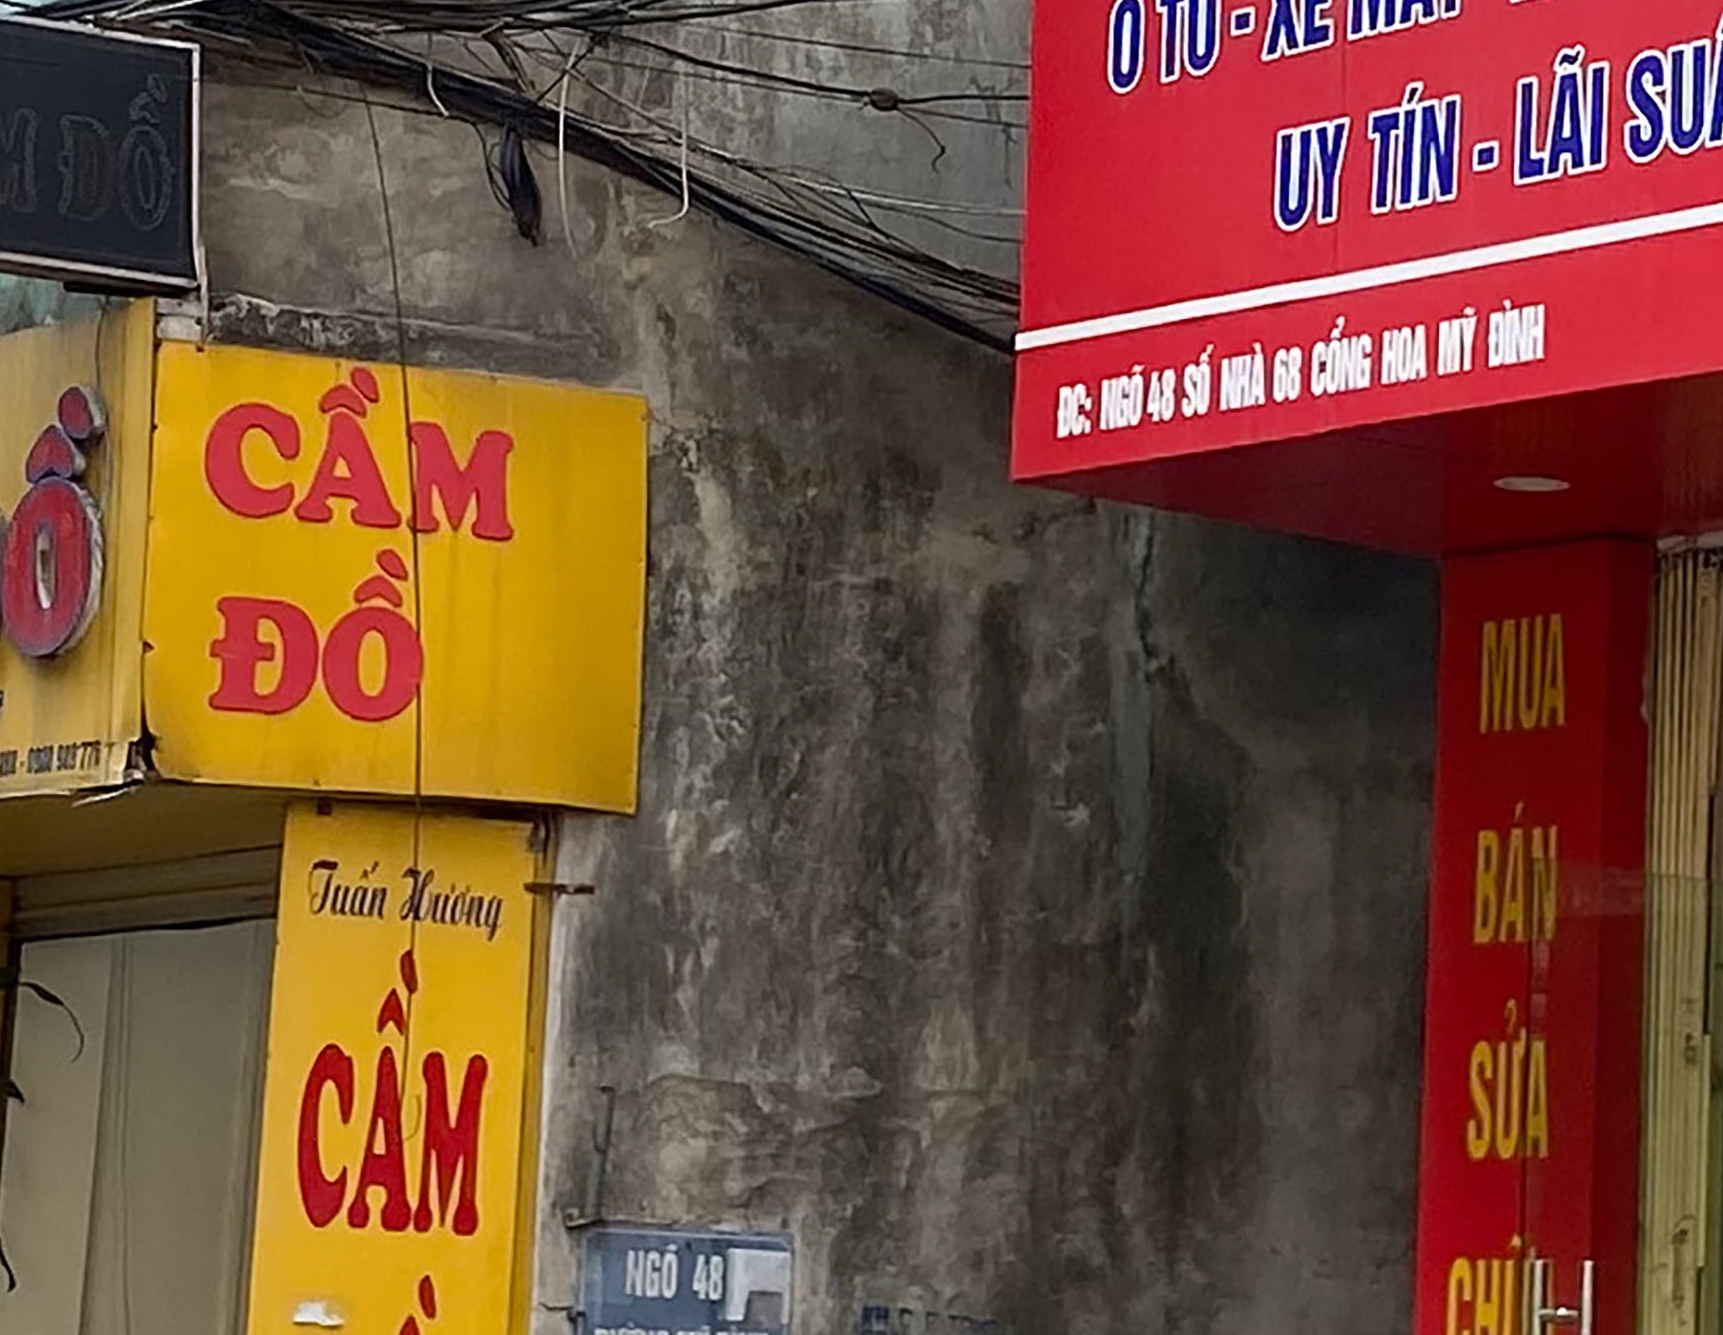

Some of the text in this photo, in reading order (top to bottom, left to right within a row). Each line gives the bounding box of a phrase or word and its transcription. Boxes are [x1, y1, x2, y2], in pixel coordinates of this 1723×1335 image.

[1274, 115, 1350, 232] UY
[1368, 80, 1462, 217] TÍN
[1512, 45, 1611, 186] LÃI
[1100, 367, 1143, 430] NGÕ
[1146, 374, 1175, 423] 48
[1182, 344, 1214, 415] SỐ
[1219, 343, 1265, 411] NHÀ
[1274, 344, 1301, 401] 68
[1310, 318, 1372, 396] CỔNG
[1382, 323, 1427, 385] HOA
[1438, 310, 1477, 374] MỸ
[1487, 300, 1545, 366] ĐÌNH
[205, 366, 514, 541] CẦM
[208, 549, 423, 722] ĐỒ
[1480, 614, 1567, 734] MUA
[1474, 802, 1558, 944] BÁN
[297, 948, 488, 1236] CẦM
[1467, 998, 1549, 1161] SỬA
[626, 1243, 724, 1301] NGÕ 48
